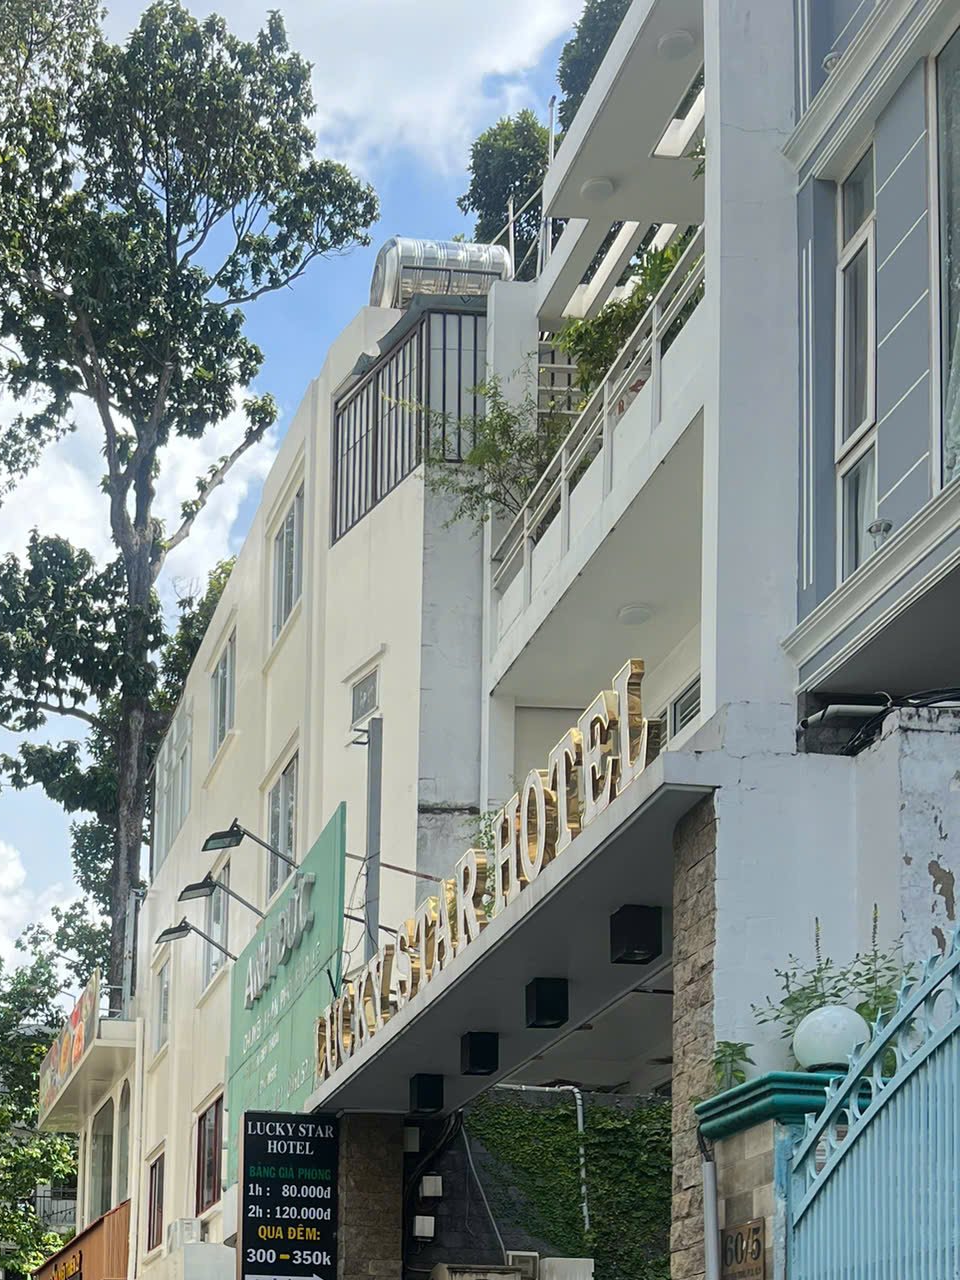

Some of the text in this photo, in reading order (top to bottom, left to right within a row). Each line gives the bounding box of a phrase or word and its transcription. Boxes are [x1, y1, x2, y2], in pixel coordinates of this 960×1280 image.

[315, 659, 654, 1091] LUCKY STAR HOTEL
[248, 1121, 334, 1138] LUCKY STAR
[267, 1140, 314, 1155] HOTEL
[281, 1184, 331, 1199] 80.000đ
[275, 1206, 331, 1220] 120.000đ
[258, 1224, 321, 1240] QUA ĐÊM:
[246, 1248, 277, 1263] 300
[292, 1250, 331, 1266] 350k
